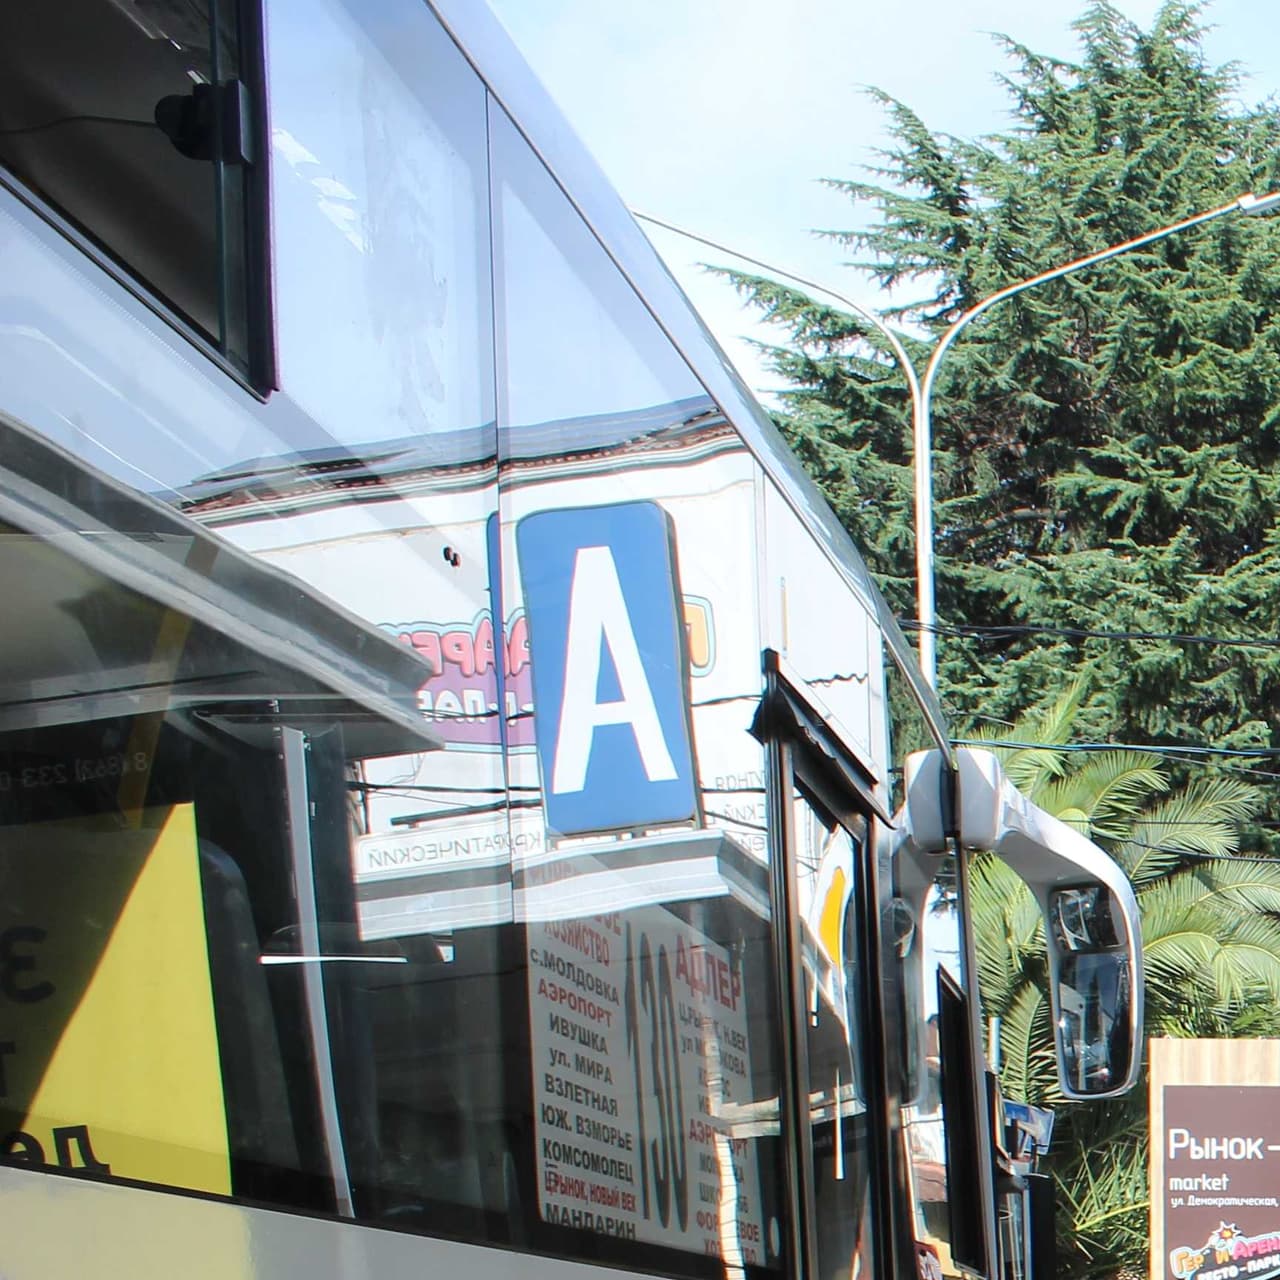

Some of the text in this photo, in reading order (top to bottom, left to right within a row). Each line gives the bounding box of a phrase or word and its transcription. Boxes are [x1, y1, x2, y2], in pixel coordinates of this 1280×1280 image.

[675, 933, 742, 1012] АДЛЕР
[538, 978, 613, 1028] АЭРОПОРТ
[549, 1012, 609, 1055] ИВУШКА
[575, 1053, 613, 1086] МИРА
[624, 919, 689, 1233] 130
[544, 1073, 619, 1118] ВЗЛЕТНАЯ
[575, 1114, 633, 1152] ВЗМОРЬЕ
[1168, 1128, 1264, 1160] Рынок
[543, 1137, 634, 1184] КОМСОМОЛЕЦ
[1168, 1173, 1230, 1191] market
[545, 1203, 637, 1241] МАНДАРИН
